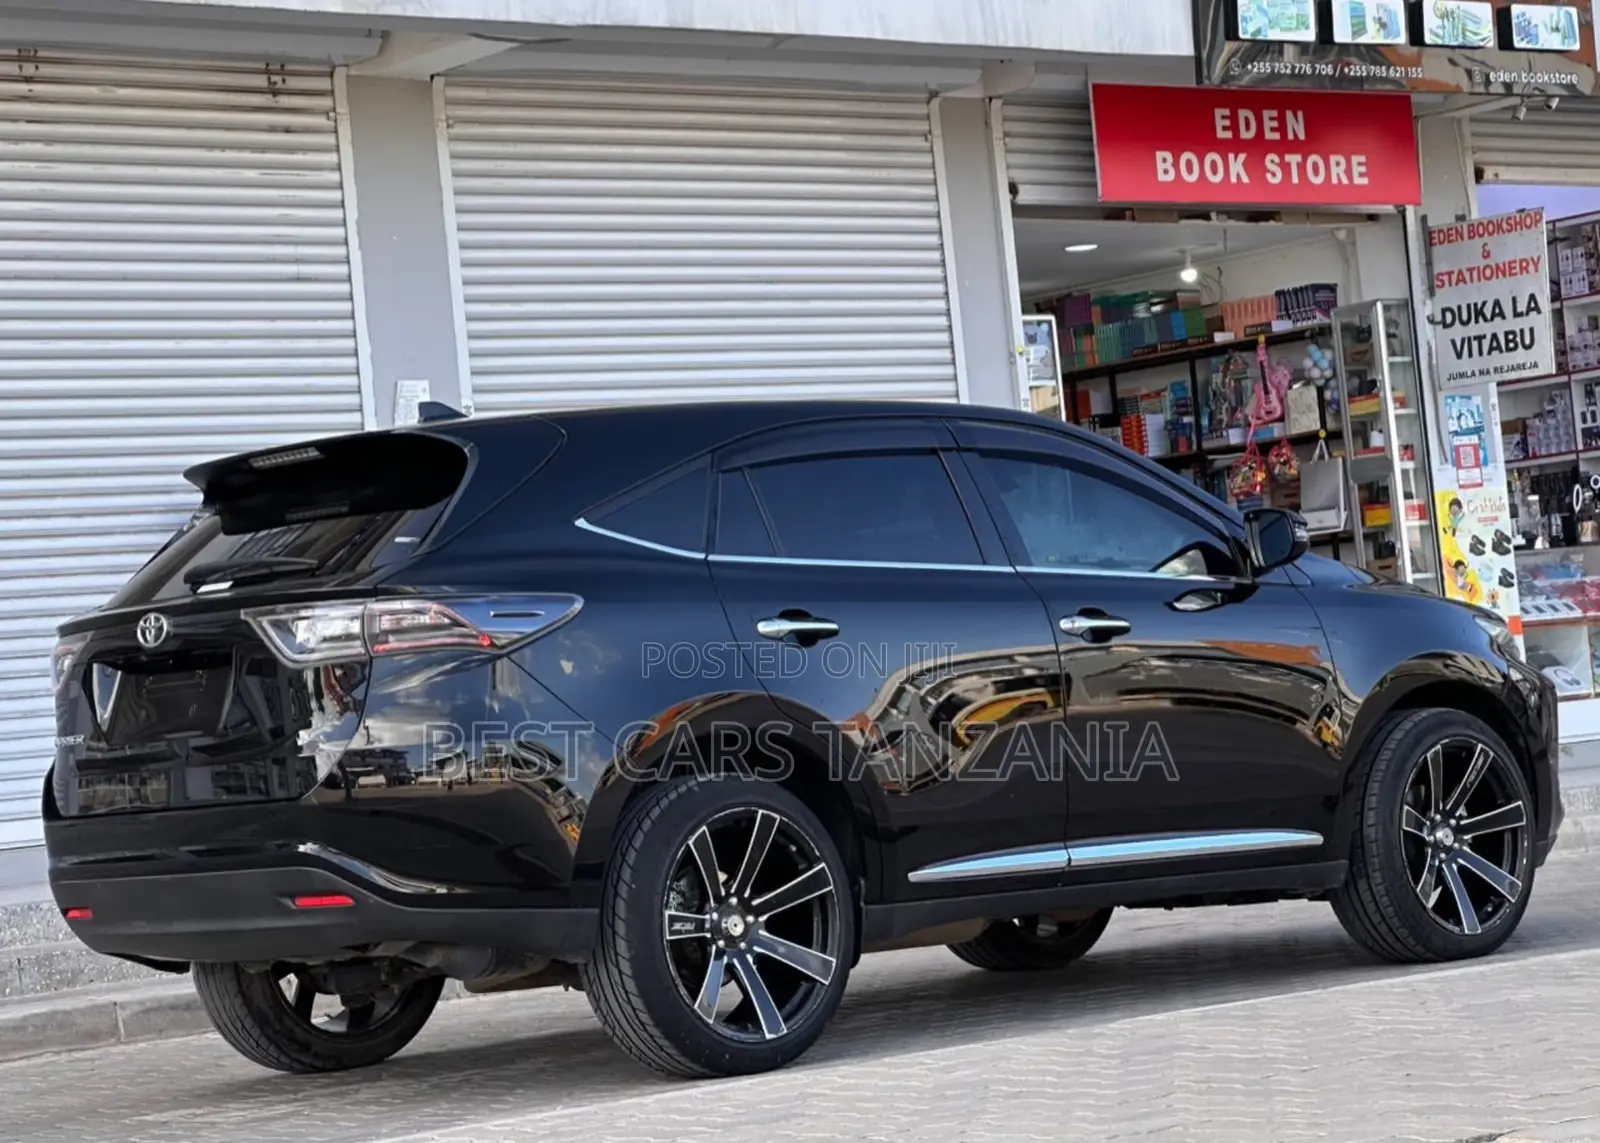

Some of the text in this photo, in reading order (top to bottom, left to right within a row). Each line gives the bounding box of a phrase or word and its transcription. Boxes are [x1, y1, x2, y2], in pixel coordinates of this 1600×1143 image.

[1247, 61, 1271, 73] +255
[1274, 62, 1292, 74] 752
[1294, 63, 1312, 75] 776
[1314, 63, 1334, 76] 706
[1344, 64, 1367, 77] +255
[1369, 65, 1387, 77] 785
[1389, 66, 1405, 77] 621
[1407, 66, 1423, 78] 155
[1489, 69, 1579, 84] eden.bookstore
[1213, 107, 1306, 141] EDEN
[1155, 150, 1369, 185] BOOK STORE
[1429, 212, 1542, 247] EDEN BOOKSHOP
[1481, 242, 1491, 260] &
[1435, 256, 1541, 289] STATIONERY
[1441, 292, 1542, 329] DUKA LA
[1450, 326, 1536, 361] VITABU
[1447, 360, 1540, 381] JUMLA NA REJAREJA
